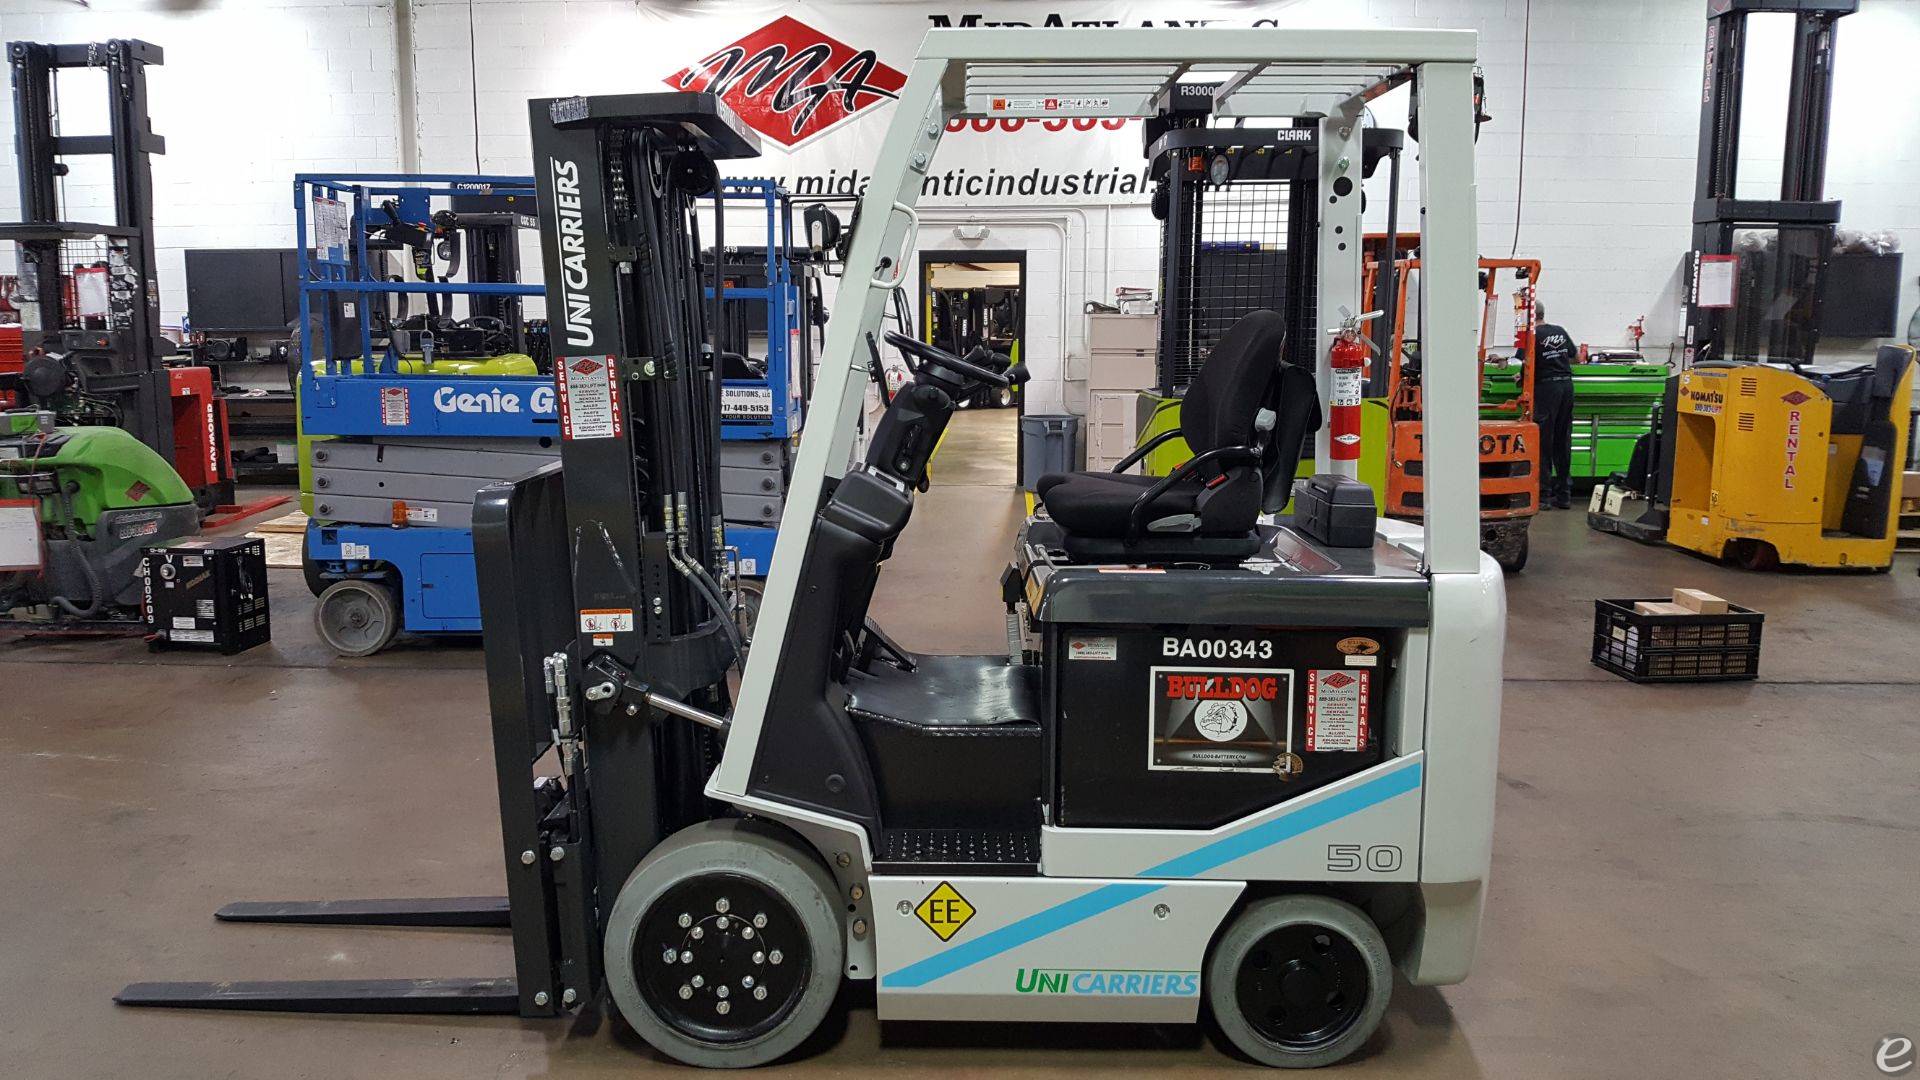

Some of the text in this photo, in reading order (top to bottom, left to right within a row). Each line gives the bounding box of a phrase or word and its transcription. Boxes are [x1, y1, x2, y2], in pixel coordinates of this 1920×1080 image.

[1277, 129, 1312, 142] CLARK
[554, 159, 595, 347] UNICARRIERS
[433, 386, 520, 413] Genie
[530, 386, 558, 414] G
[557, 360, 571, 435] SERVICE
[607, 358, 621, 433] RENTALS
[1690, 390, 1724, 404] KOMATSU
[206, 403, 217, 472] RAYMOND
[1414, 433, 1526, 455] TOTA
[1784, 410, 1800, 490] RENTAL
[142, 557, 154, 624] CH00209
[1163, 636, 1273, 659] BA00343
[1166, 674, 1279, 701] BULLDOG
[1359, 673, 1367, 747] RENTALS
[1327, 844, 1403, 873] 50
[929, 899, 962, 924] EE
[1016, 967, 1200, 996] UNICARRIERS
